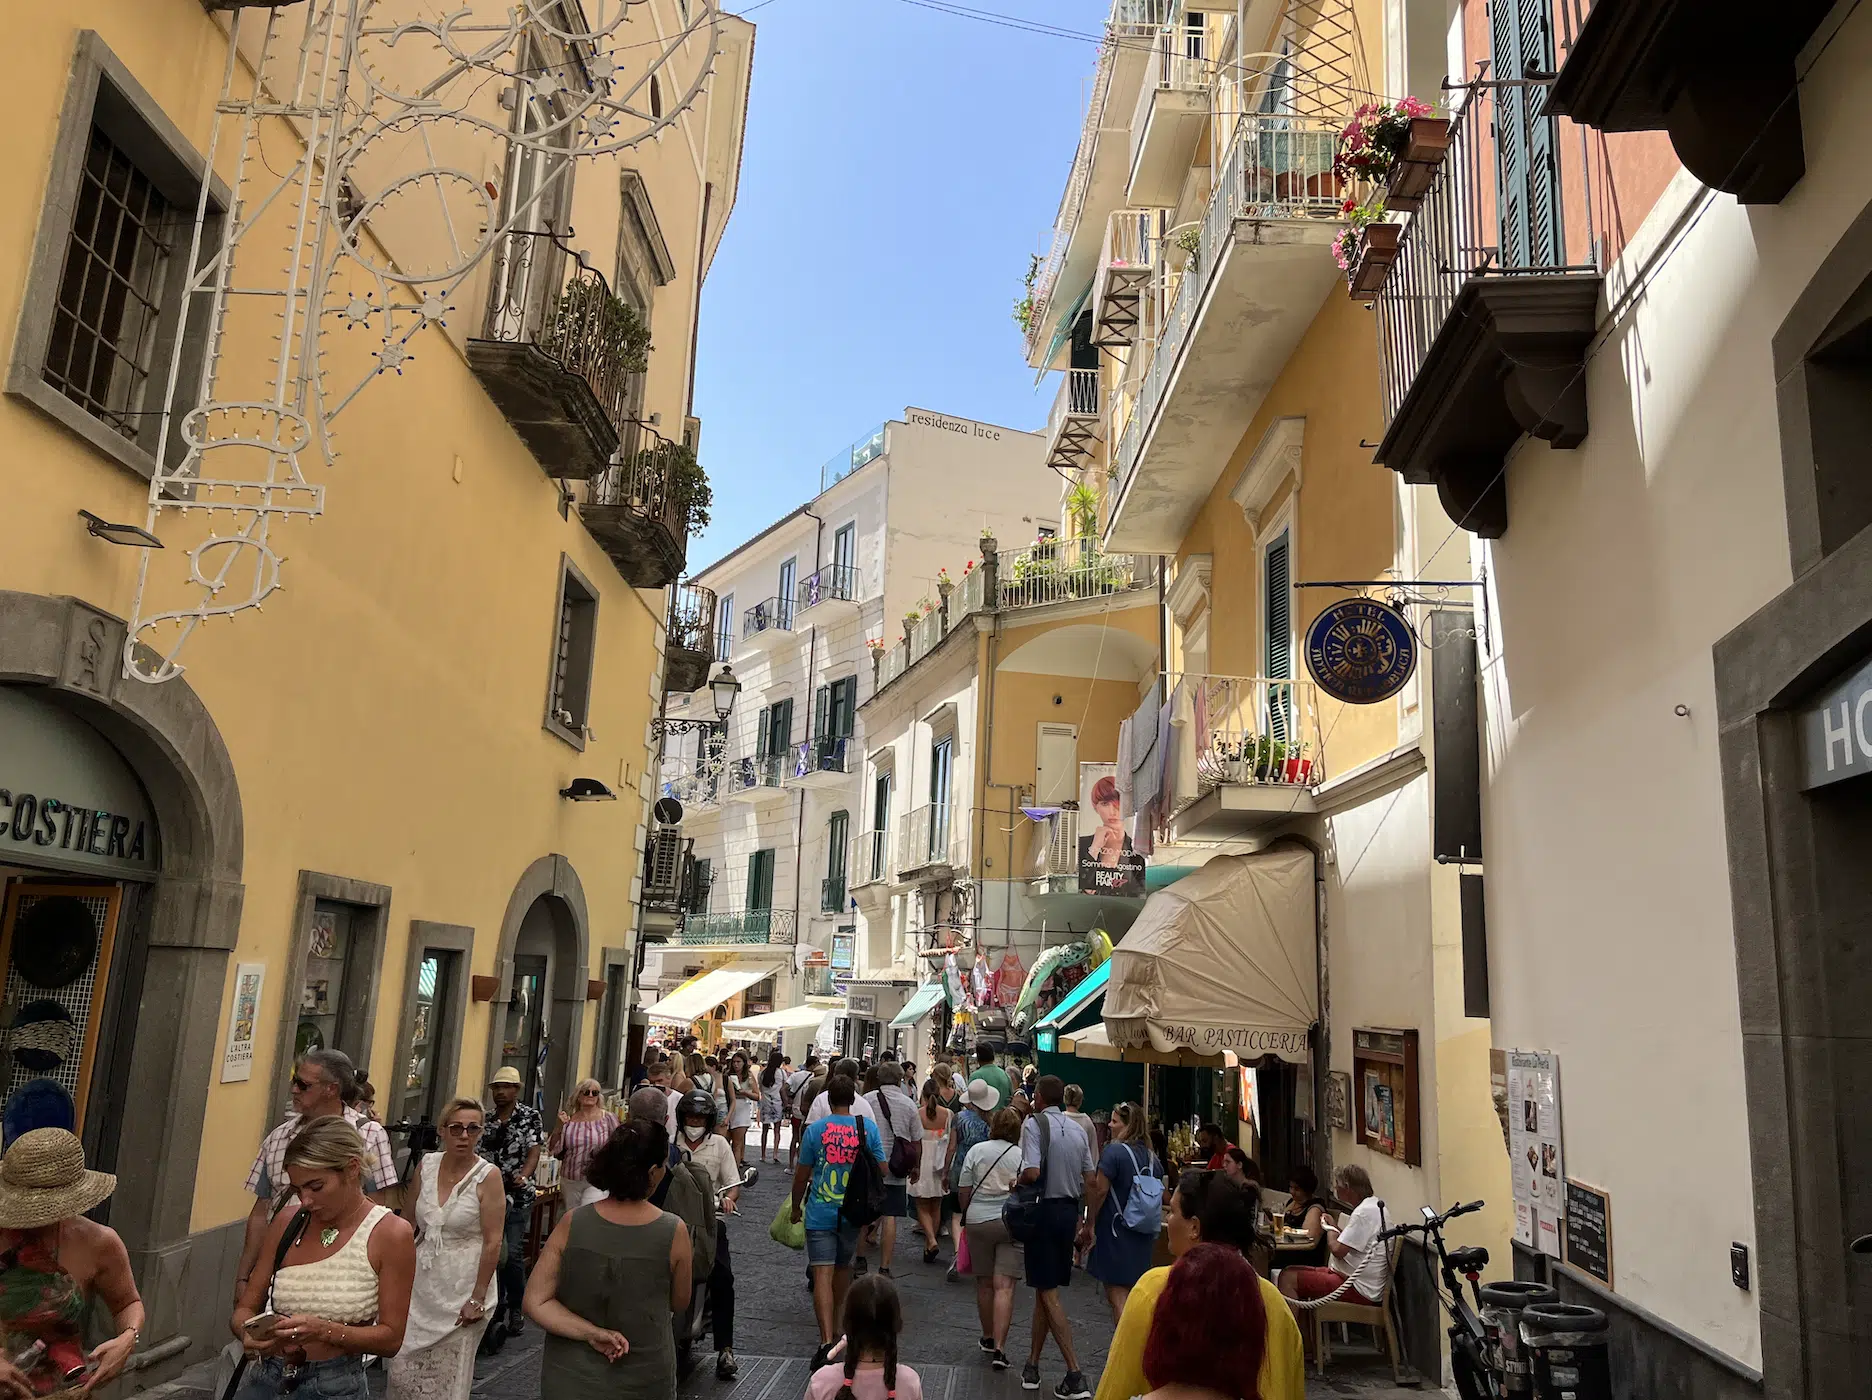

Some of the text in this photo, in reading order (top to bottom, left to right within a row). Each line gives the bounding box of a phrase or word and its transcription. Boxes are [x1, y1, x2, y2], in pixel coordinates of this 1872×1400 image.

[912, 414, 1000, 441] residenza luce
[230, 1043, 251, 1053] L'ALTRA
[1163, 1025, 1199, 1047] BAR
[1204, 1028, 1307, 1053] PASTICCERIA
[226, 1052, 252, 1063] COSTIERA
